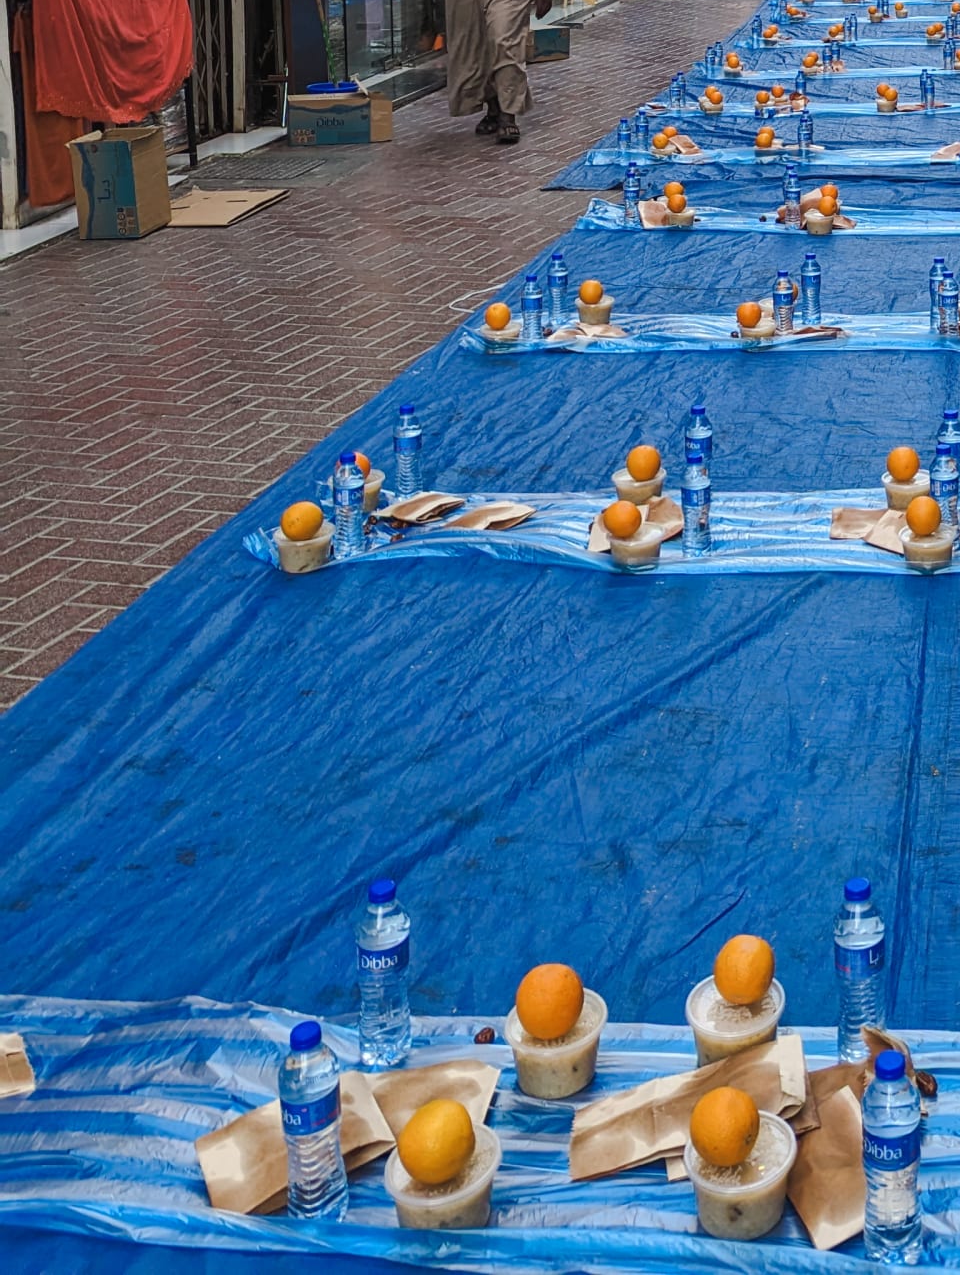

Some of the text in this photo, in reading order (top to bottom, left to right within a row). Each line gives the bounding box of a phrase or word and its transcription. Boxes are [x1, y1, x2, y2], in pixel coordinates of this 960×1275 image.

[316, 116, 345, 127] Dibba
[361, 954, 398, 970] Dibba
[863, 1137, 902, 1161] Dibba
